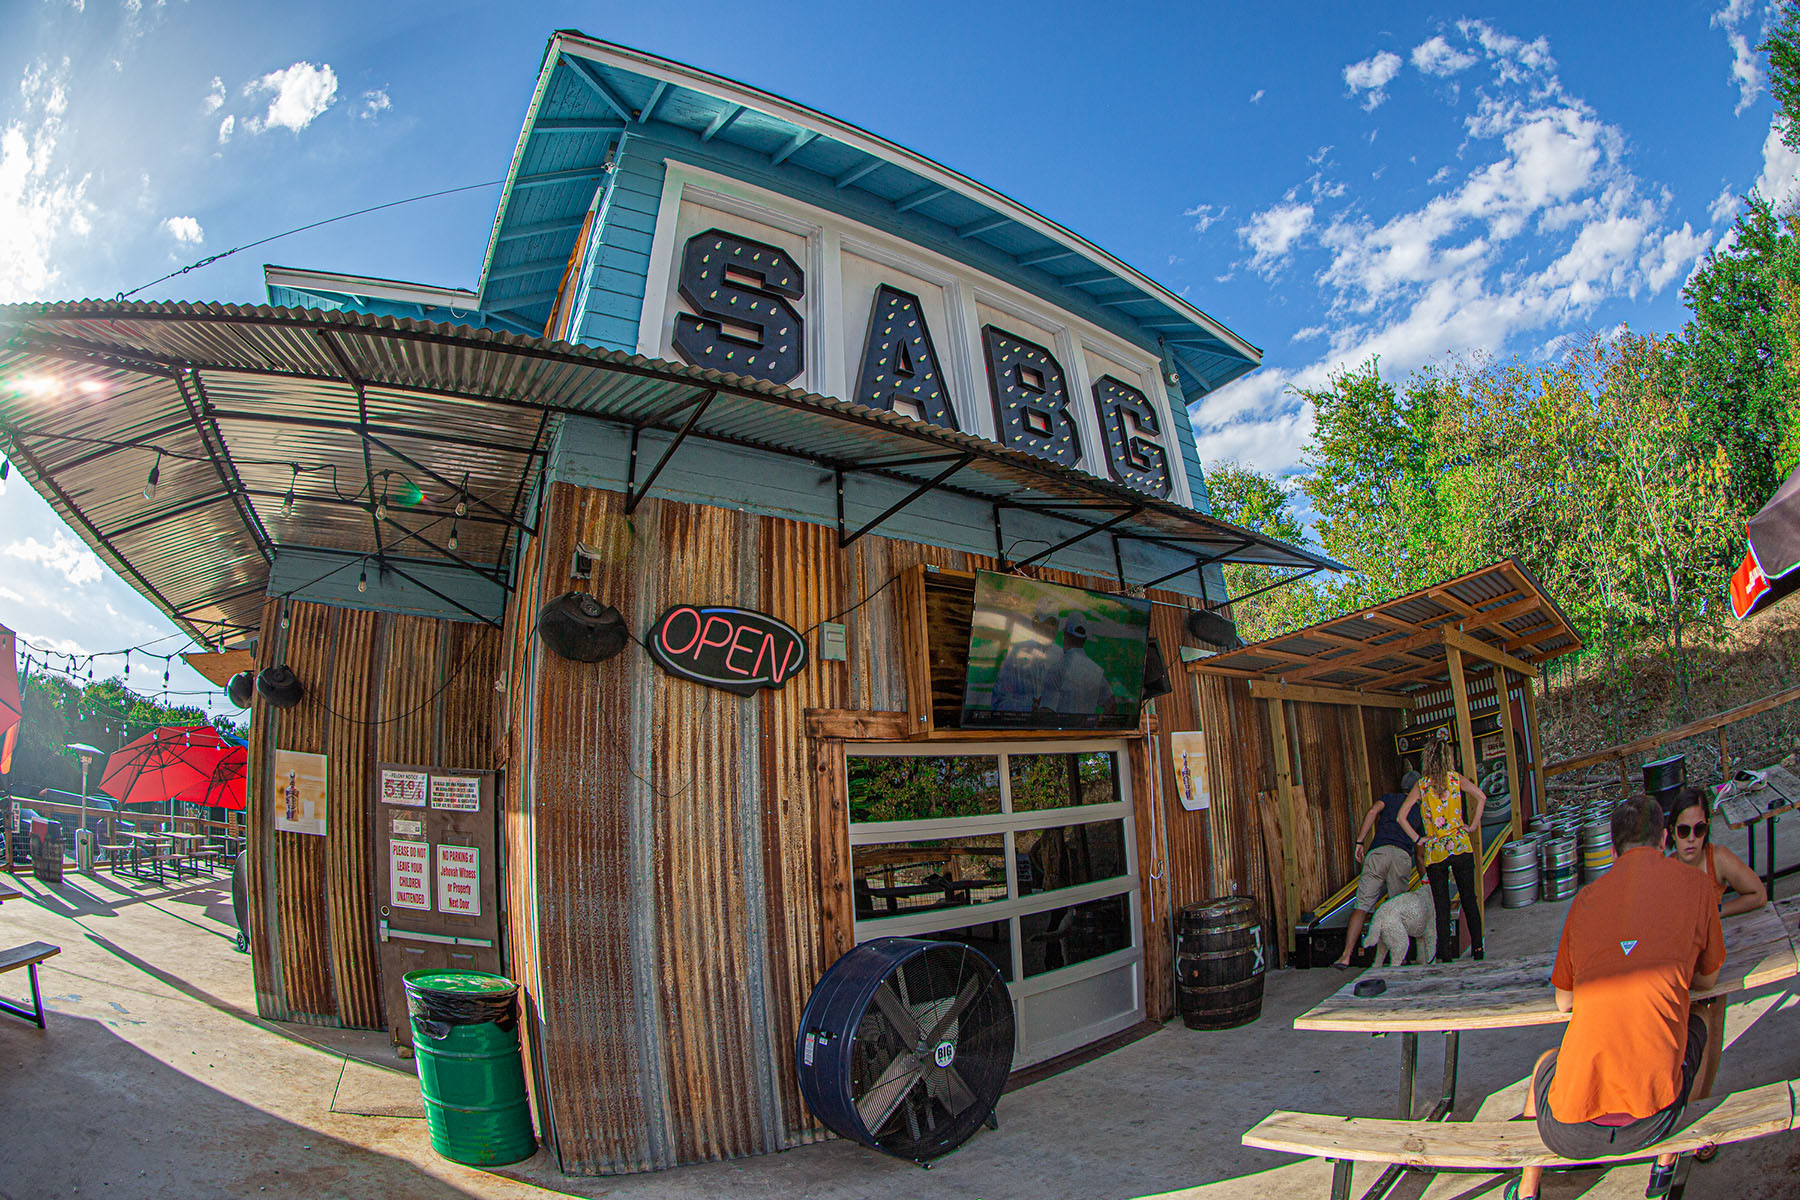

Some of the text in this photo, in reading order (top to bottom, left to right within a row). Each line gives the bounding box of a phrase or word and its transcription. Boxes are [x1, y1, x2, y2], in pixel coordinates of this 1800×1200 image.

[671, 227, 1173, 499] SABG
[661, 607, 795, 684] OPEN
[384, 778, 424, 799] 51%
[393, 845, 426, 858] PLEASE DO NOT
[442, 850, 474, 863] NO PARKING at
[396, 860, 423, 873] LEAVE YOUR
[440, 866, 476, 879] Jehovah Witness
[399, 876, 421, 889] CHILDREN
[447, 882, 471, 896] or Property
[396, 891, 425, 905] UNATTENDED
[448, 897, 470, 910] Next Door
[938, 1044, 952, 1059] BIG
